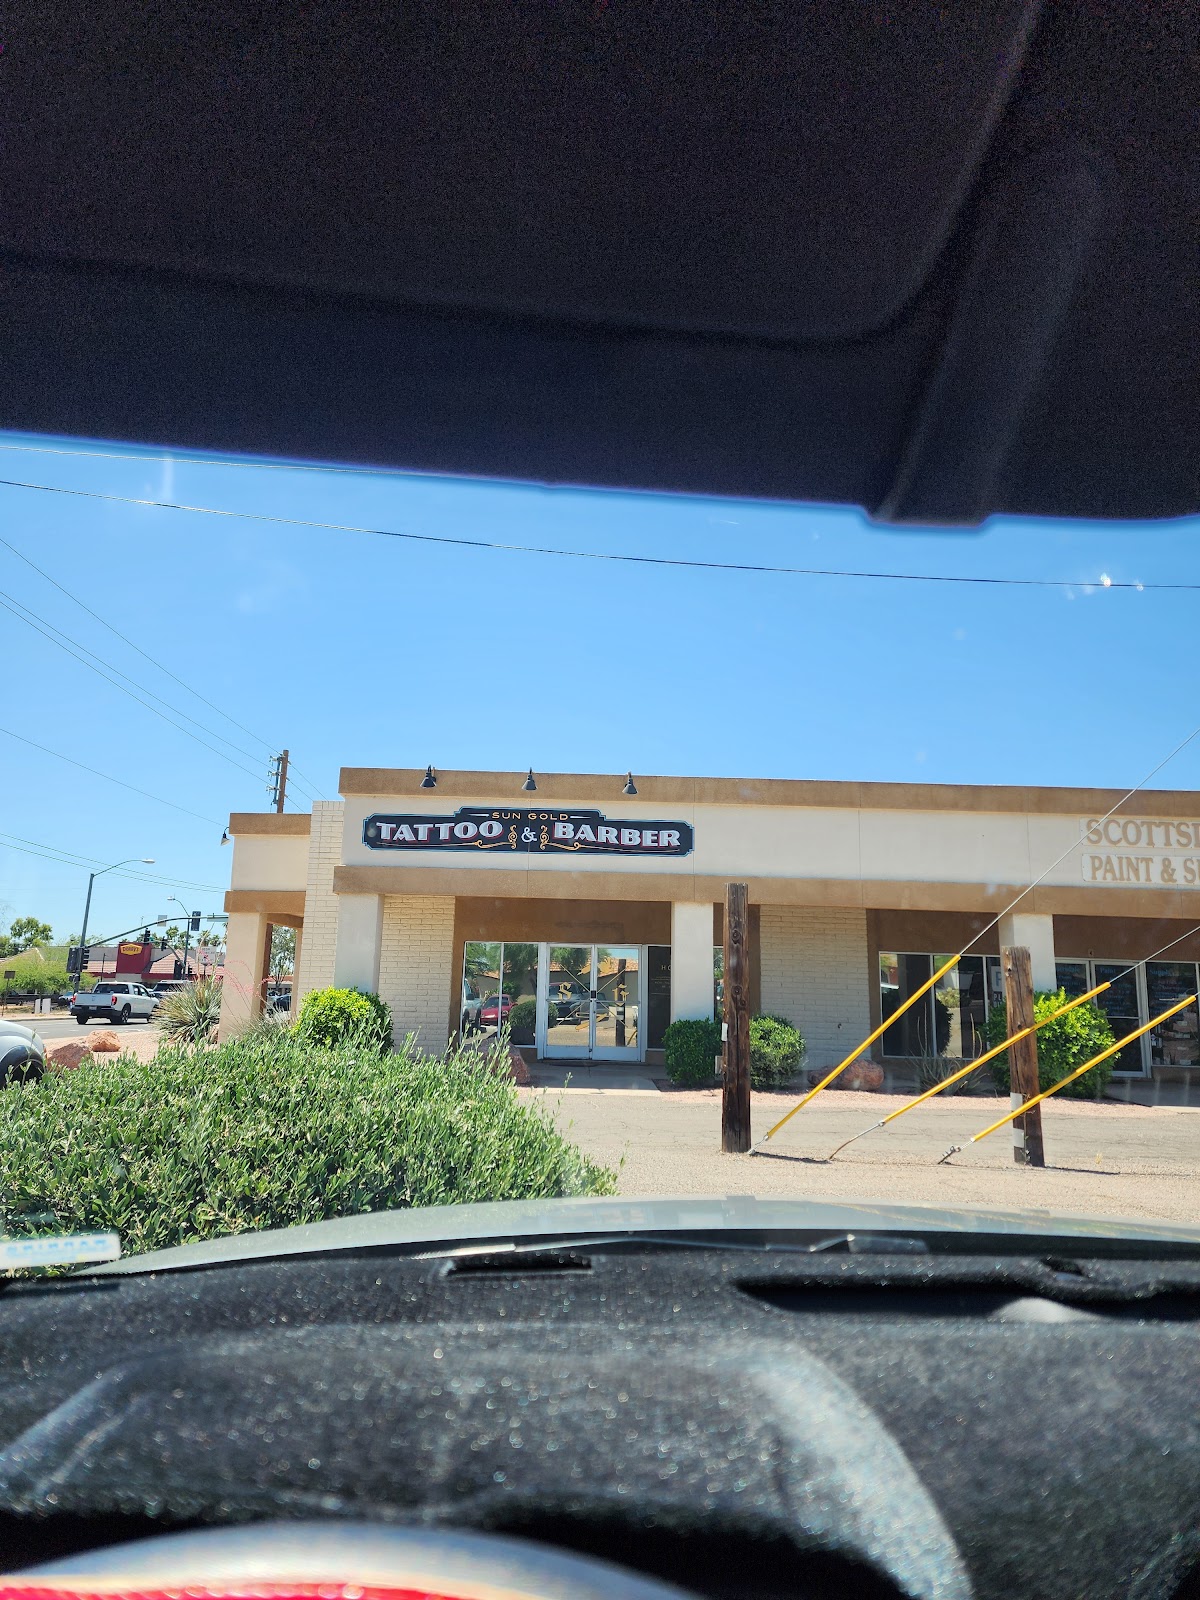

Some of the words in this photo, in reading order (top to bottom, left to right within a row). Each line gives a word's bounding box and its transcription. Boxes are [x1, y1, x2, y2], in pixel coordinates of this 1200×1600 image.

[491, 812, 521, 820] SUN
[528, 813, 569, 821] GOLD
[376, 819, 504, 842] TATTOO
[521, 826, 538, 843] &
[553, 821, 681, 848] BARBER
[1089, 855, 1154, 882] PAINT
[1160, 857, 1178, 884] &
[1183, 858, 1200, 884] S
